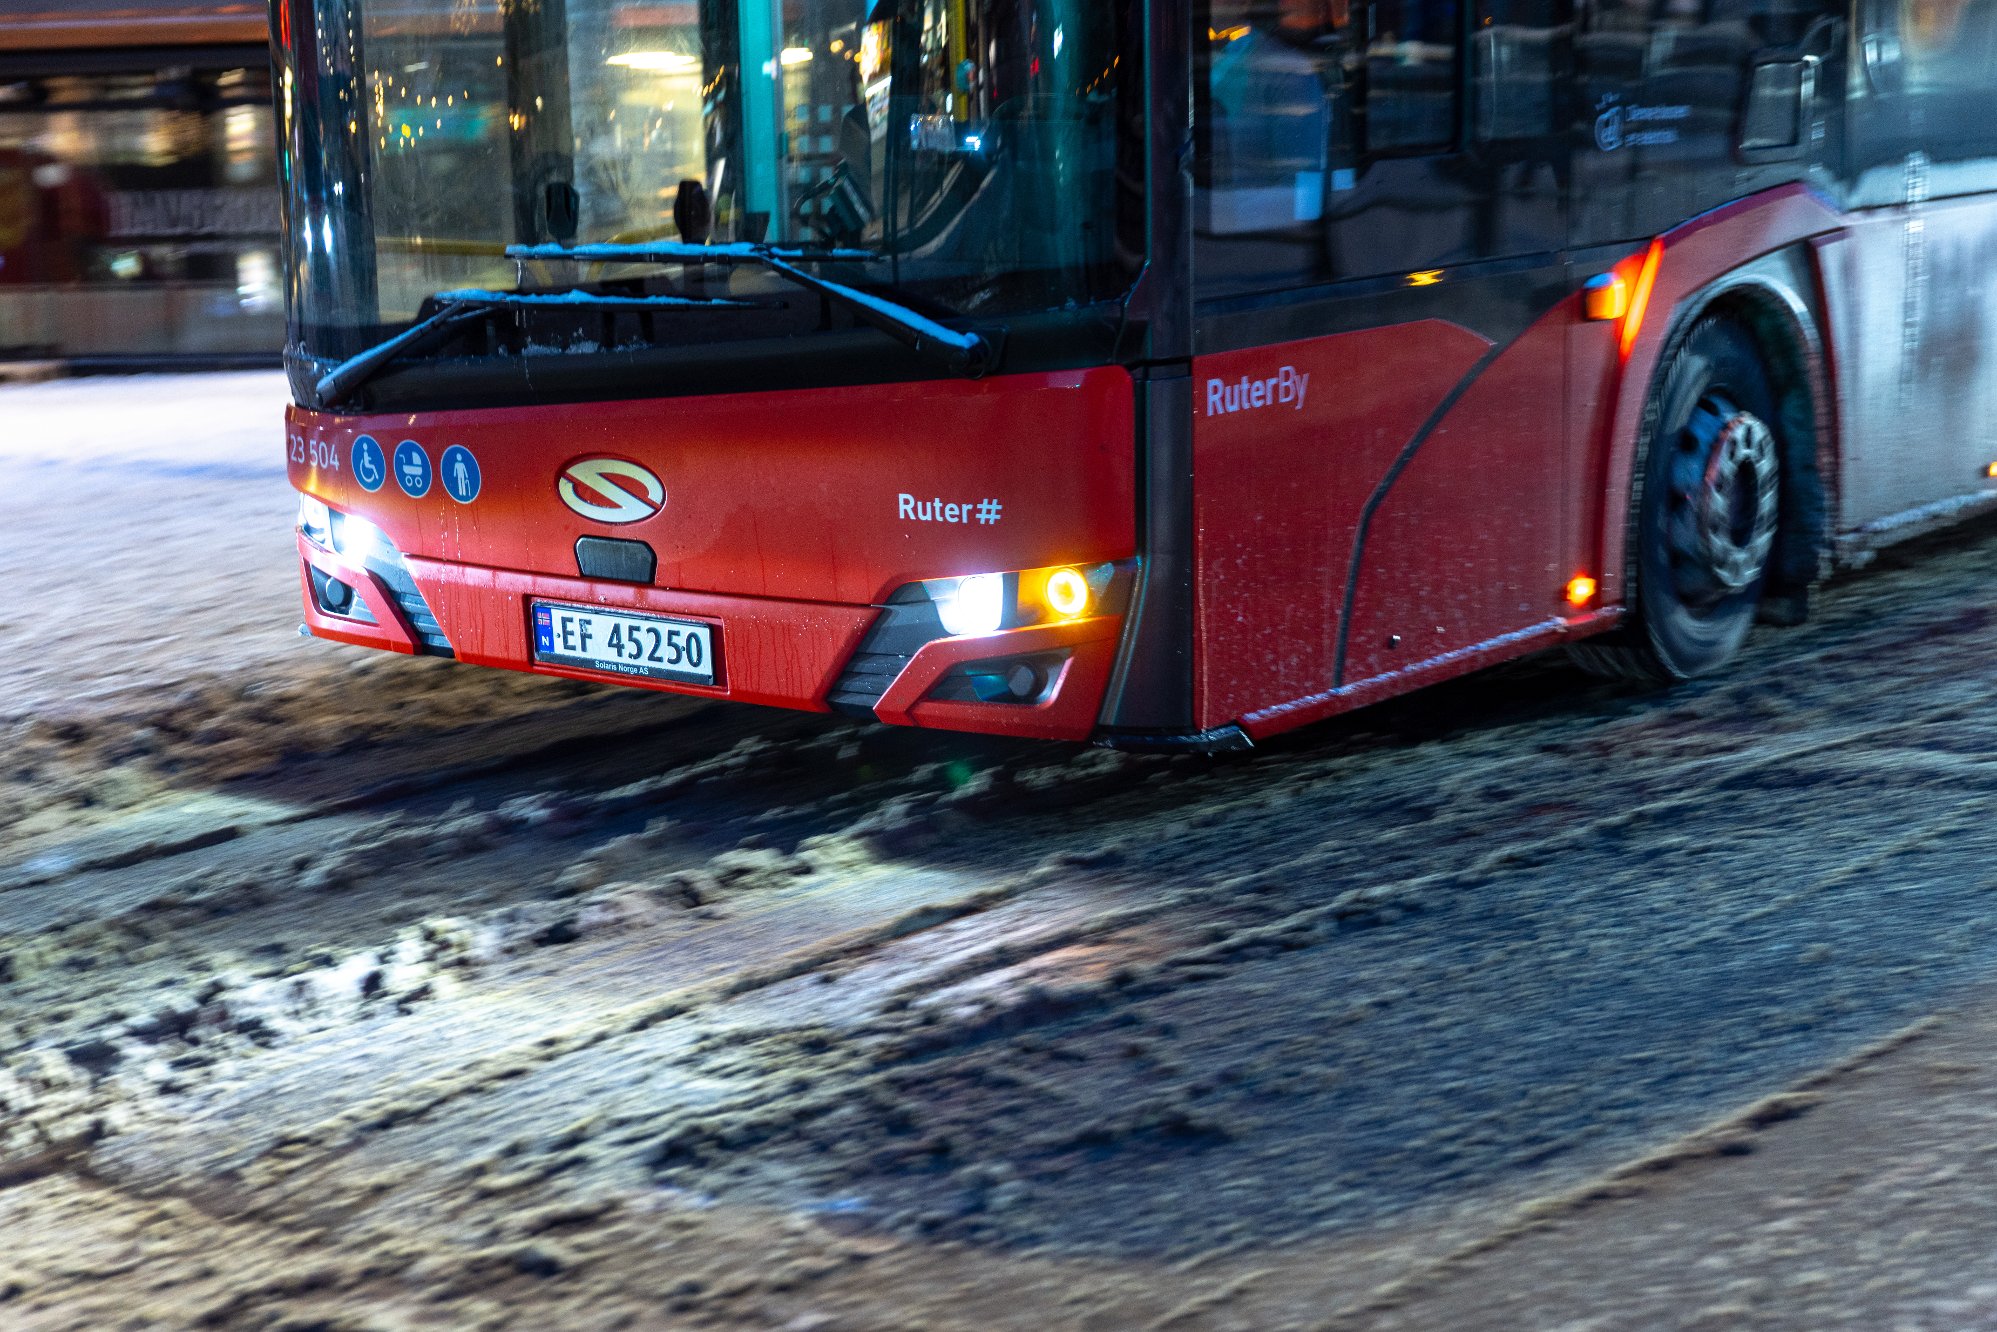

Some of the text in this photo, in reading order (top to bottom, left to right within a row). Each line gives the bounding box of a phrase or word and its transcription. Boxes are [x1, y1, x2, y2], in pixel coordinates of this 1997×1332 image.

[1206, 365, 1310, 417] RuterBy
[290, 433, 340, 471] 23 504
[541, 635, 550, 647] N
[560, 616, 703, 668] EF 45250
[595, 660, 649, 675] Solaris Norge AS
